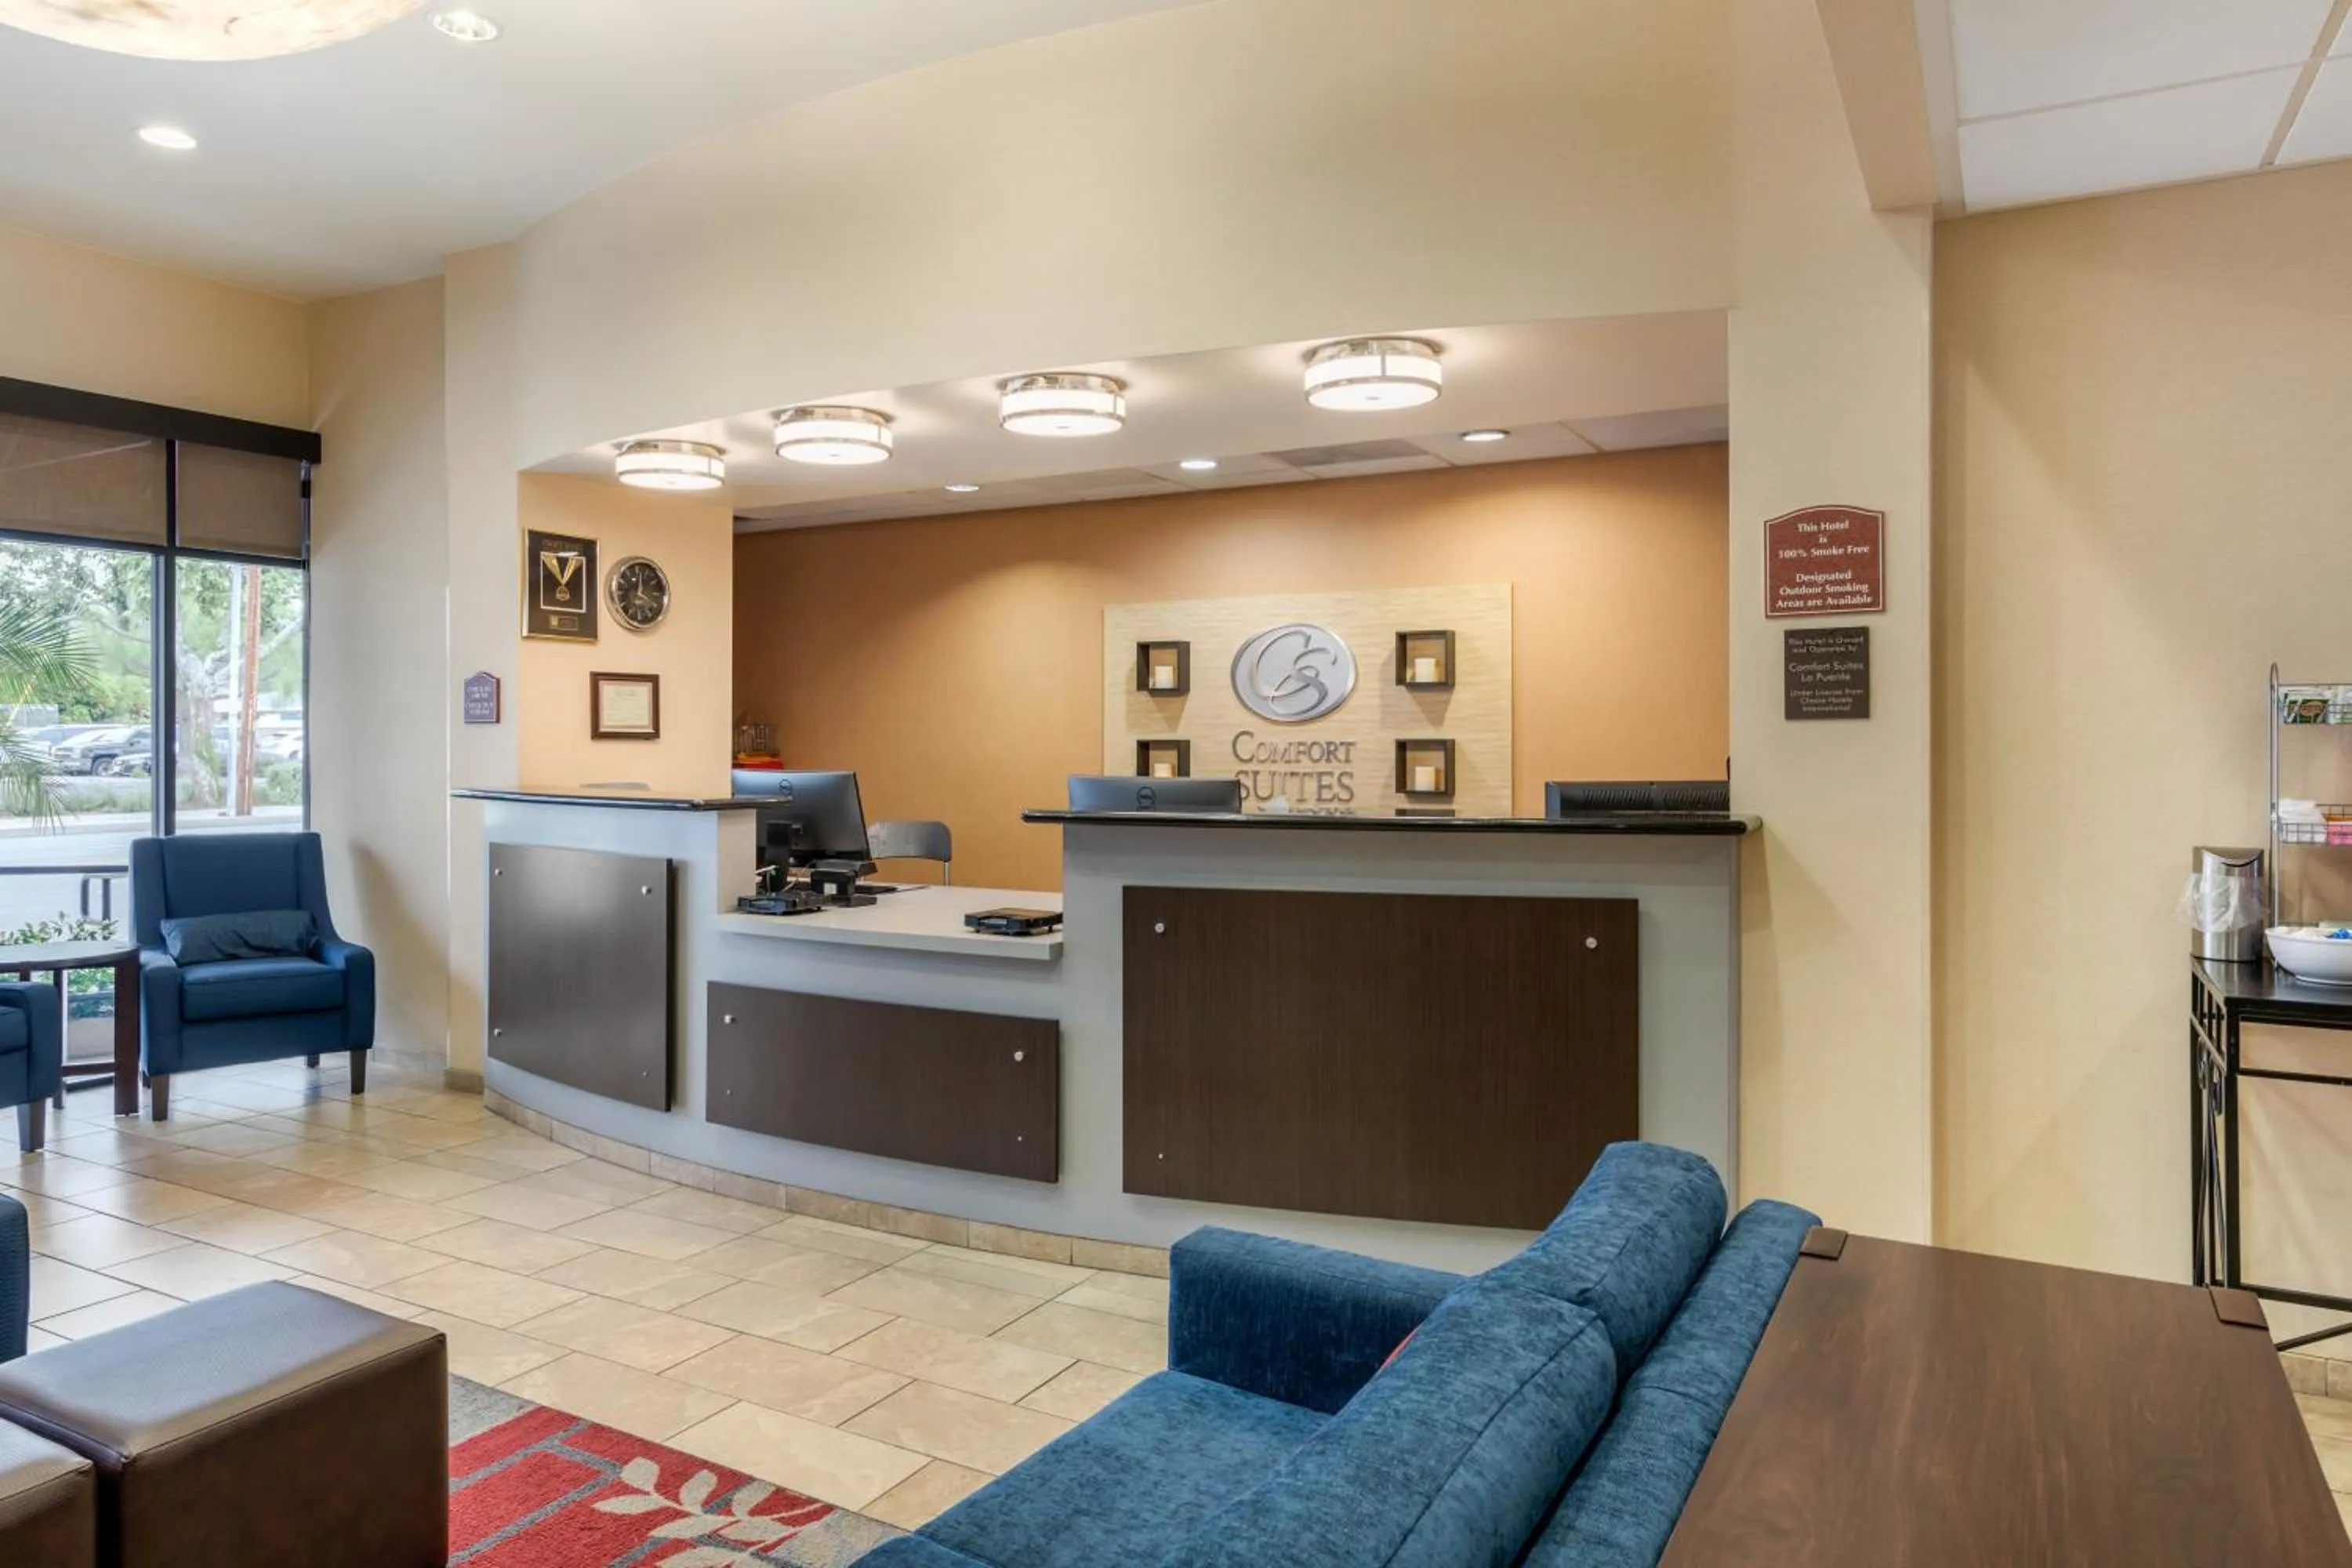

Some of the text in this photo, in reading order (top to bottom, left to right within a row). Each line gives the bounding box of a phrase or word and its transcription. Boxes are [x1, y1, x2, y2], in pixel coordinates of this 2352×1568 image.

[1798, 520, 1849, 532] This Hotel
[1819, 535, 1828, 543] is
[1778, 545, 1870, 559] 100% Smoke Free
[1796, 570, 1852, 583] Designated
[1779, 583, 1869, 595] Outdoor Smoking
[1776, 594, 1873, 608] Areas are Available
[1788, 662, 1831, 672] Comfort
[1235, 770, 1355, 803] SUITES
